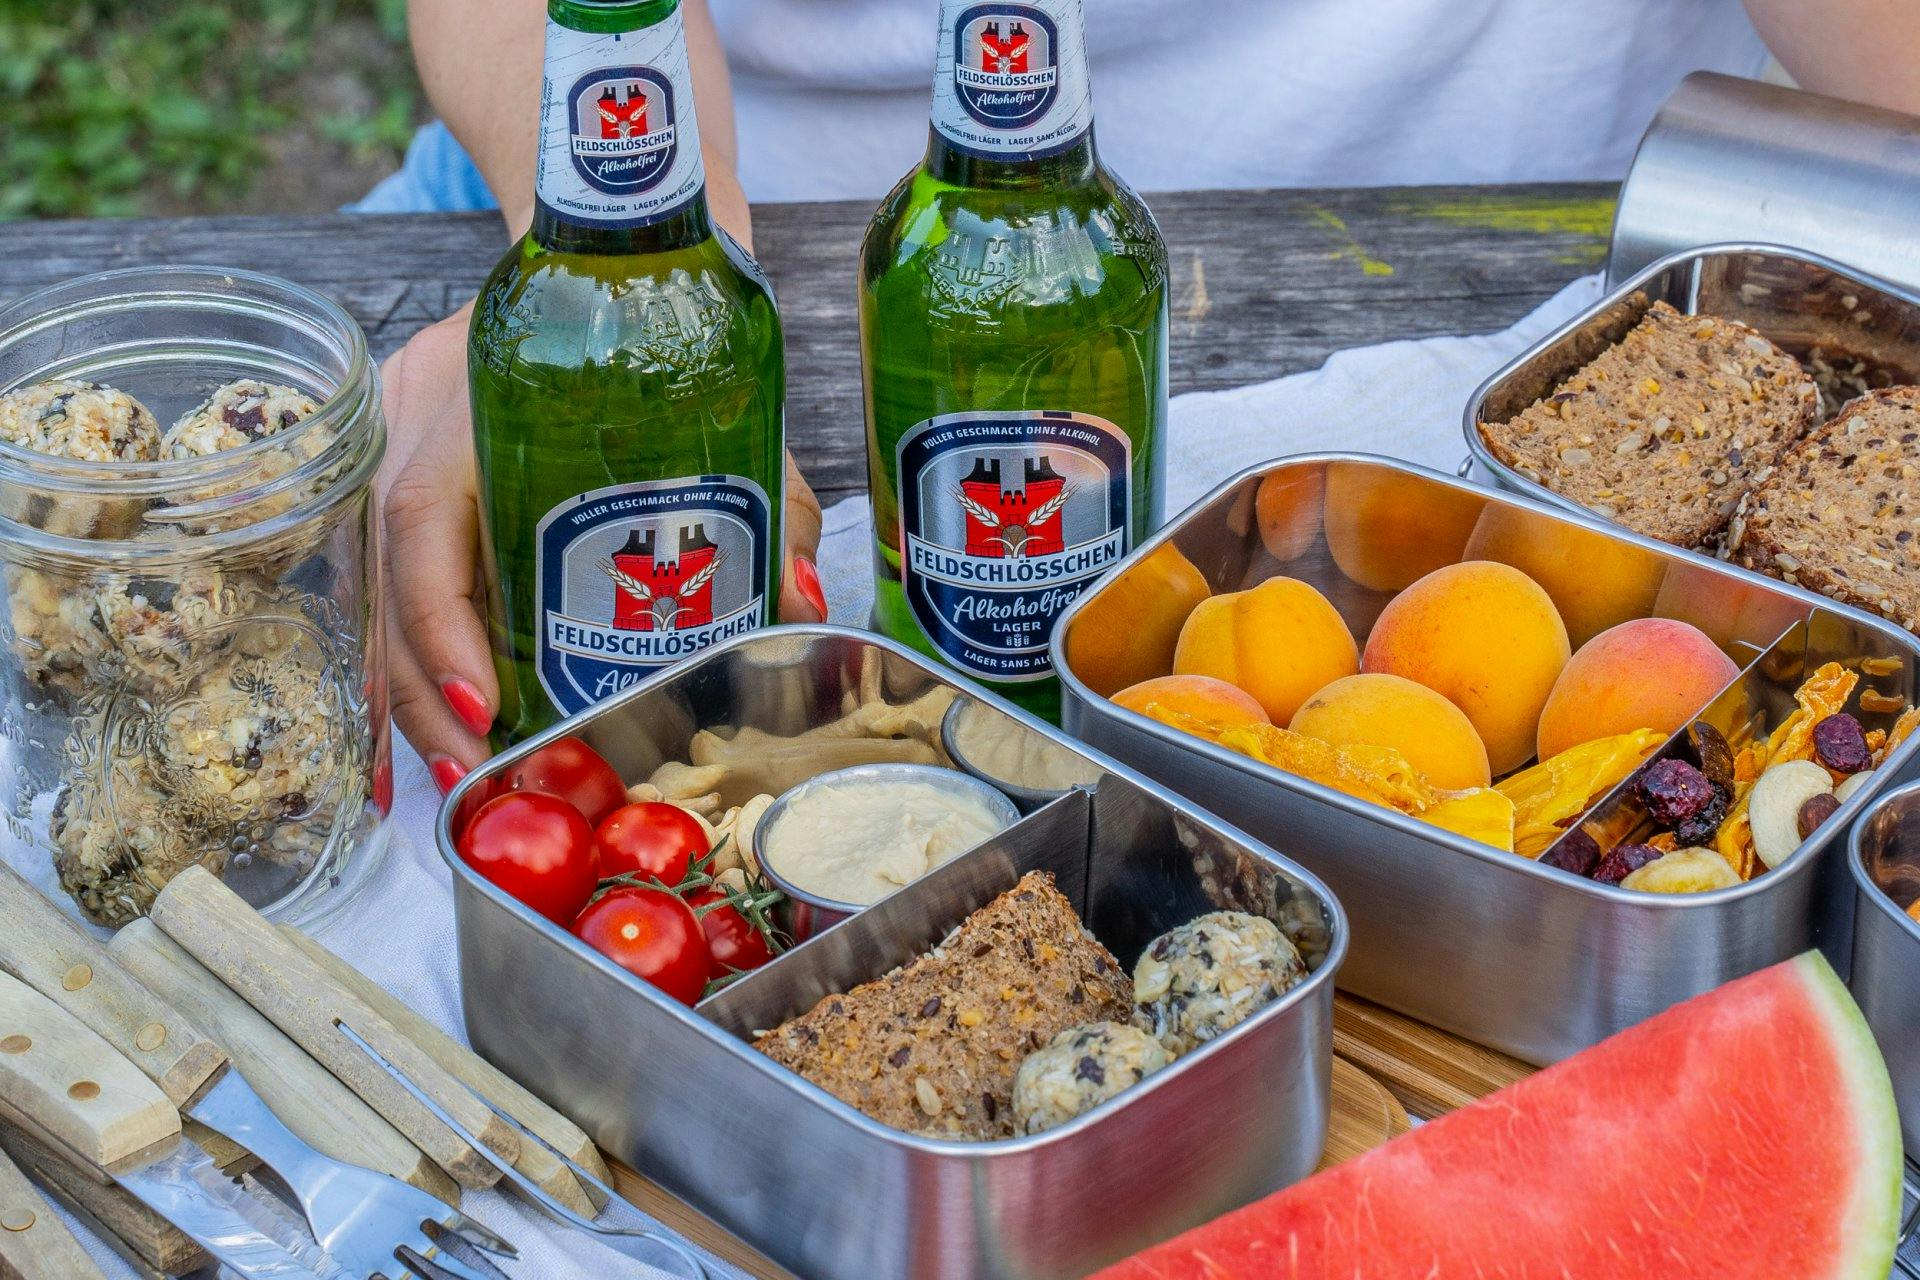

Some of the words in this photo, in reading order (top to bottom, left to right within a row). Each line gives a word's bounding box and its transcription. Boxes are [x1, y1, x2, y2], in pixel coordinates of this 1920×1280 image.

[959, 70, 1053, 87] FELDSCHLÖSSCHEN
[977, 91, 1036, 107] Alkoholfrei
[575, 130, 672, 152] FELDSCHLÖSSCHEN
[978, 135, 1002, 145] LAGER
[1008, 136, 1034, 146] LAGER
[1036, 132, 1055, 143] SANS
[598, 152, 657, 176] Alkoholfrei
[556, 196, 600, 212] ALKOHOLFREI
[602, 204, 627, 213] LAGER
[633, 200, 659, 211] LAGER
[660, 193, 678, 204] SANS
[922, 431, 955, 450] VOLLER
[956, 426, 1022, 438] GESCHMACK
[1026, 426, 1057, 435] OHNE
[1059, 427, 1101, 446] ALKOHOL
[571, 505, 608, 526] VOLLER
[611, 494, 680, 511] GESCHMACK
[684, 491, 712, 502] OHNE
[714, 492, 750, 510] ALKOHOL
[914, 540, 1116, 582] FELDSCHLÖSSCHEN
[953, 583, 1082, 623] Alkoholfrei
[554, 607, 757, 656] FELDSCHLÖSSCHEN
[993, 621, 1041, 633] LAGER
[963, 649, 997, 667] LAGER
[1001, 660, 1030, 668] SANS
